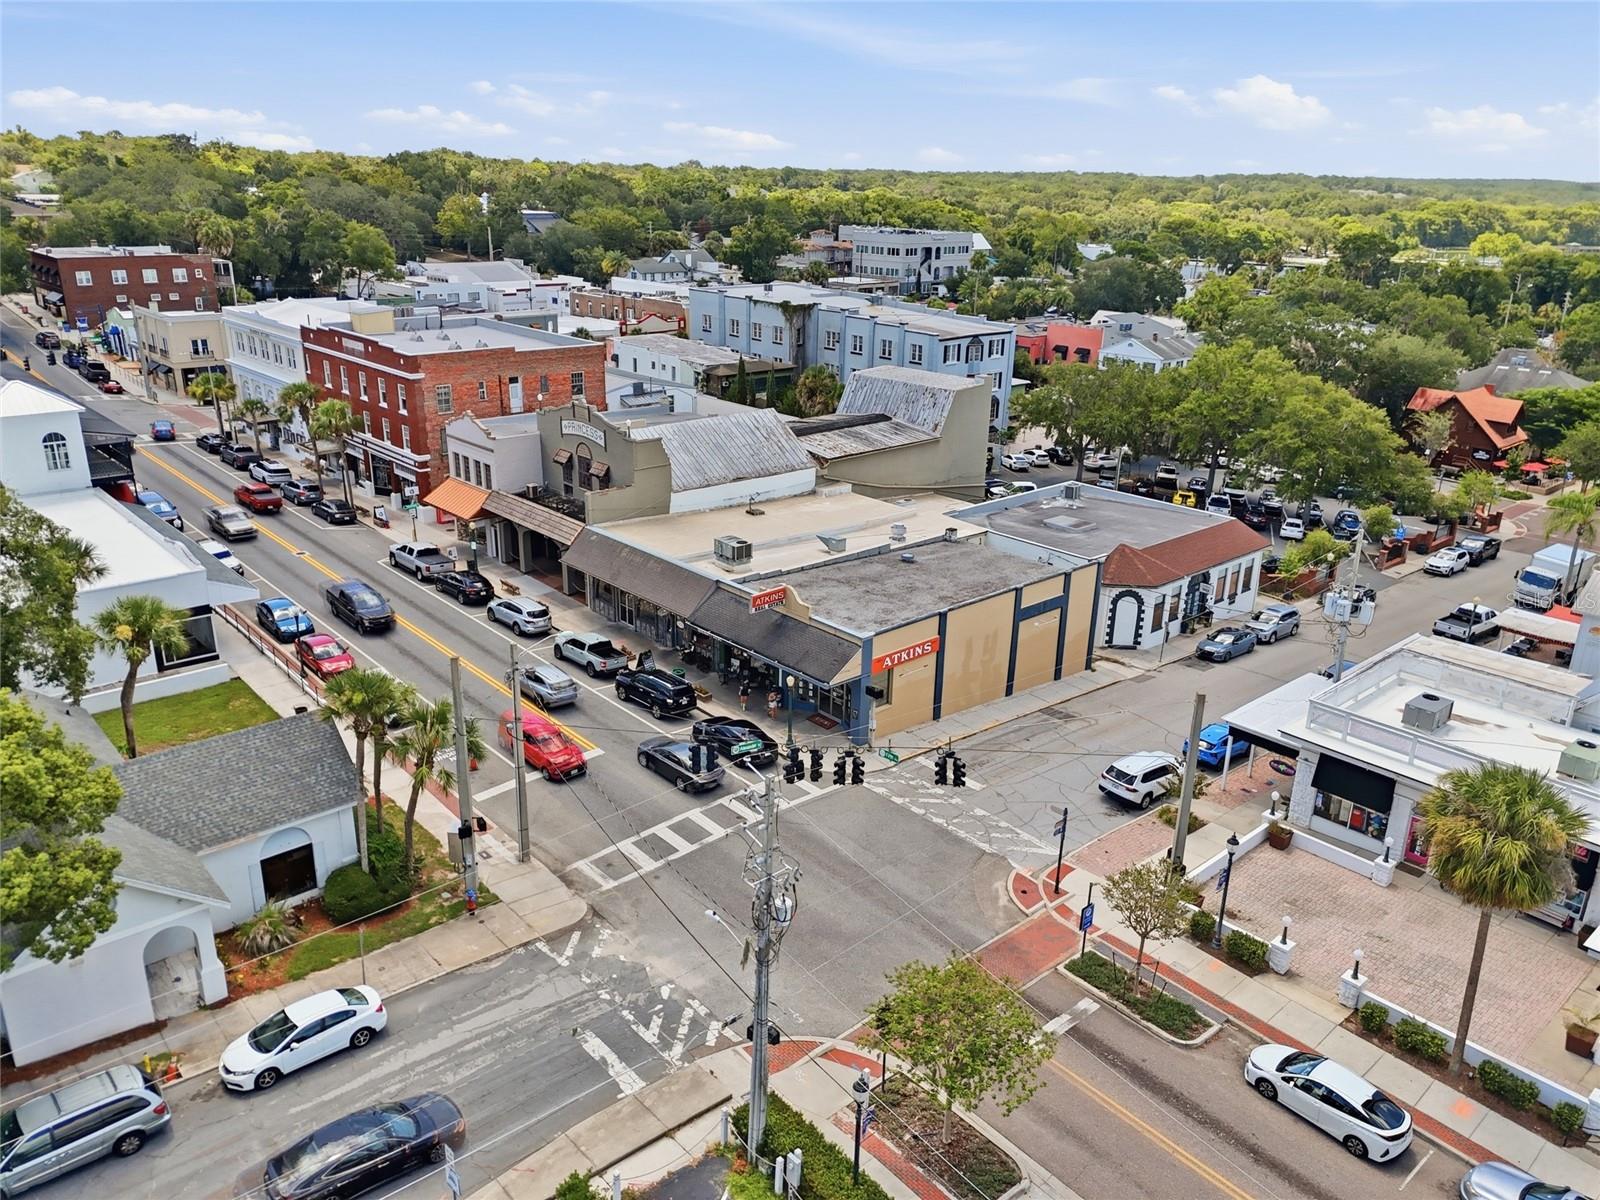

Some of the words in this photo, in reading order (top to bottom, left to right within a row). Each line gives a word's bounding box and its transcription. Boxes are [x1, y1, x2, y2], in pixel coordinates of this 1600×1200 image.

[567, 421, 599, 439] PRINCESS
[755, 591, 784, 606] ATKINS
[883, 642, 932, 668] ATKINS
